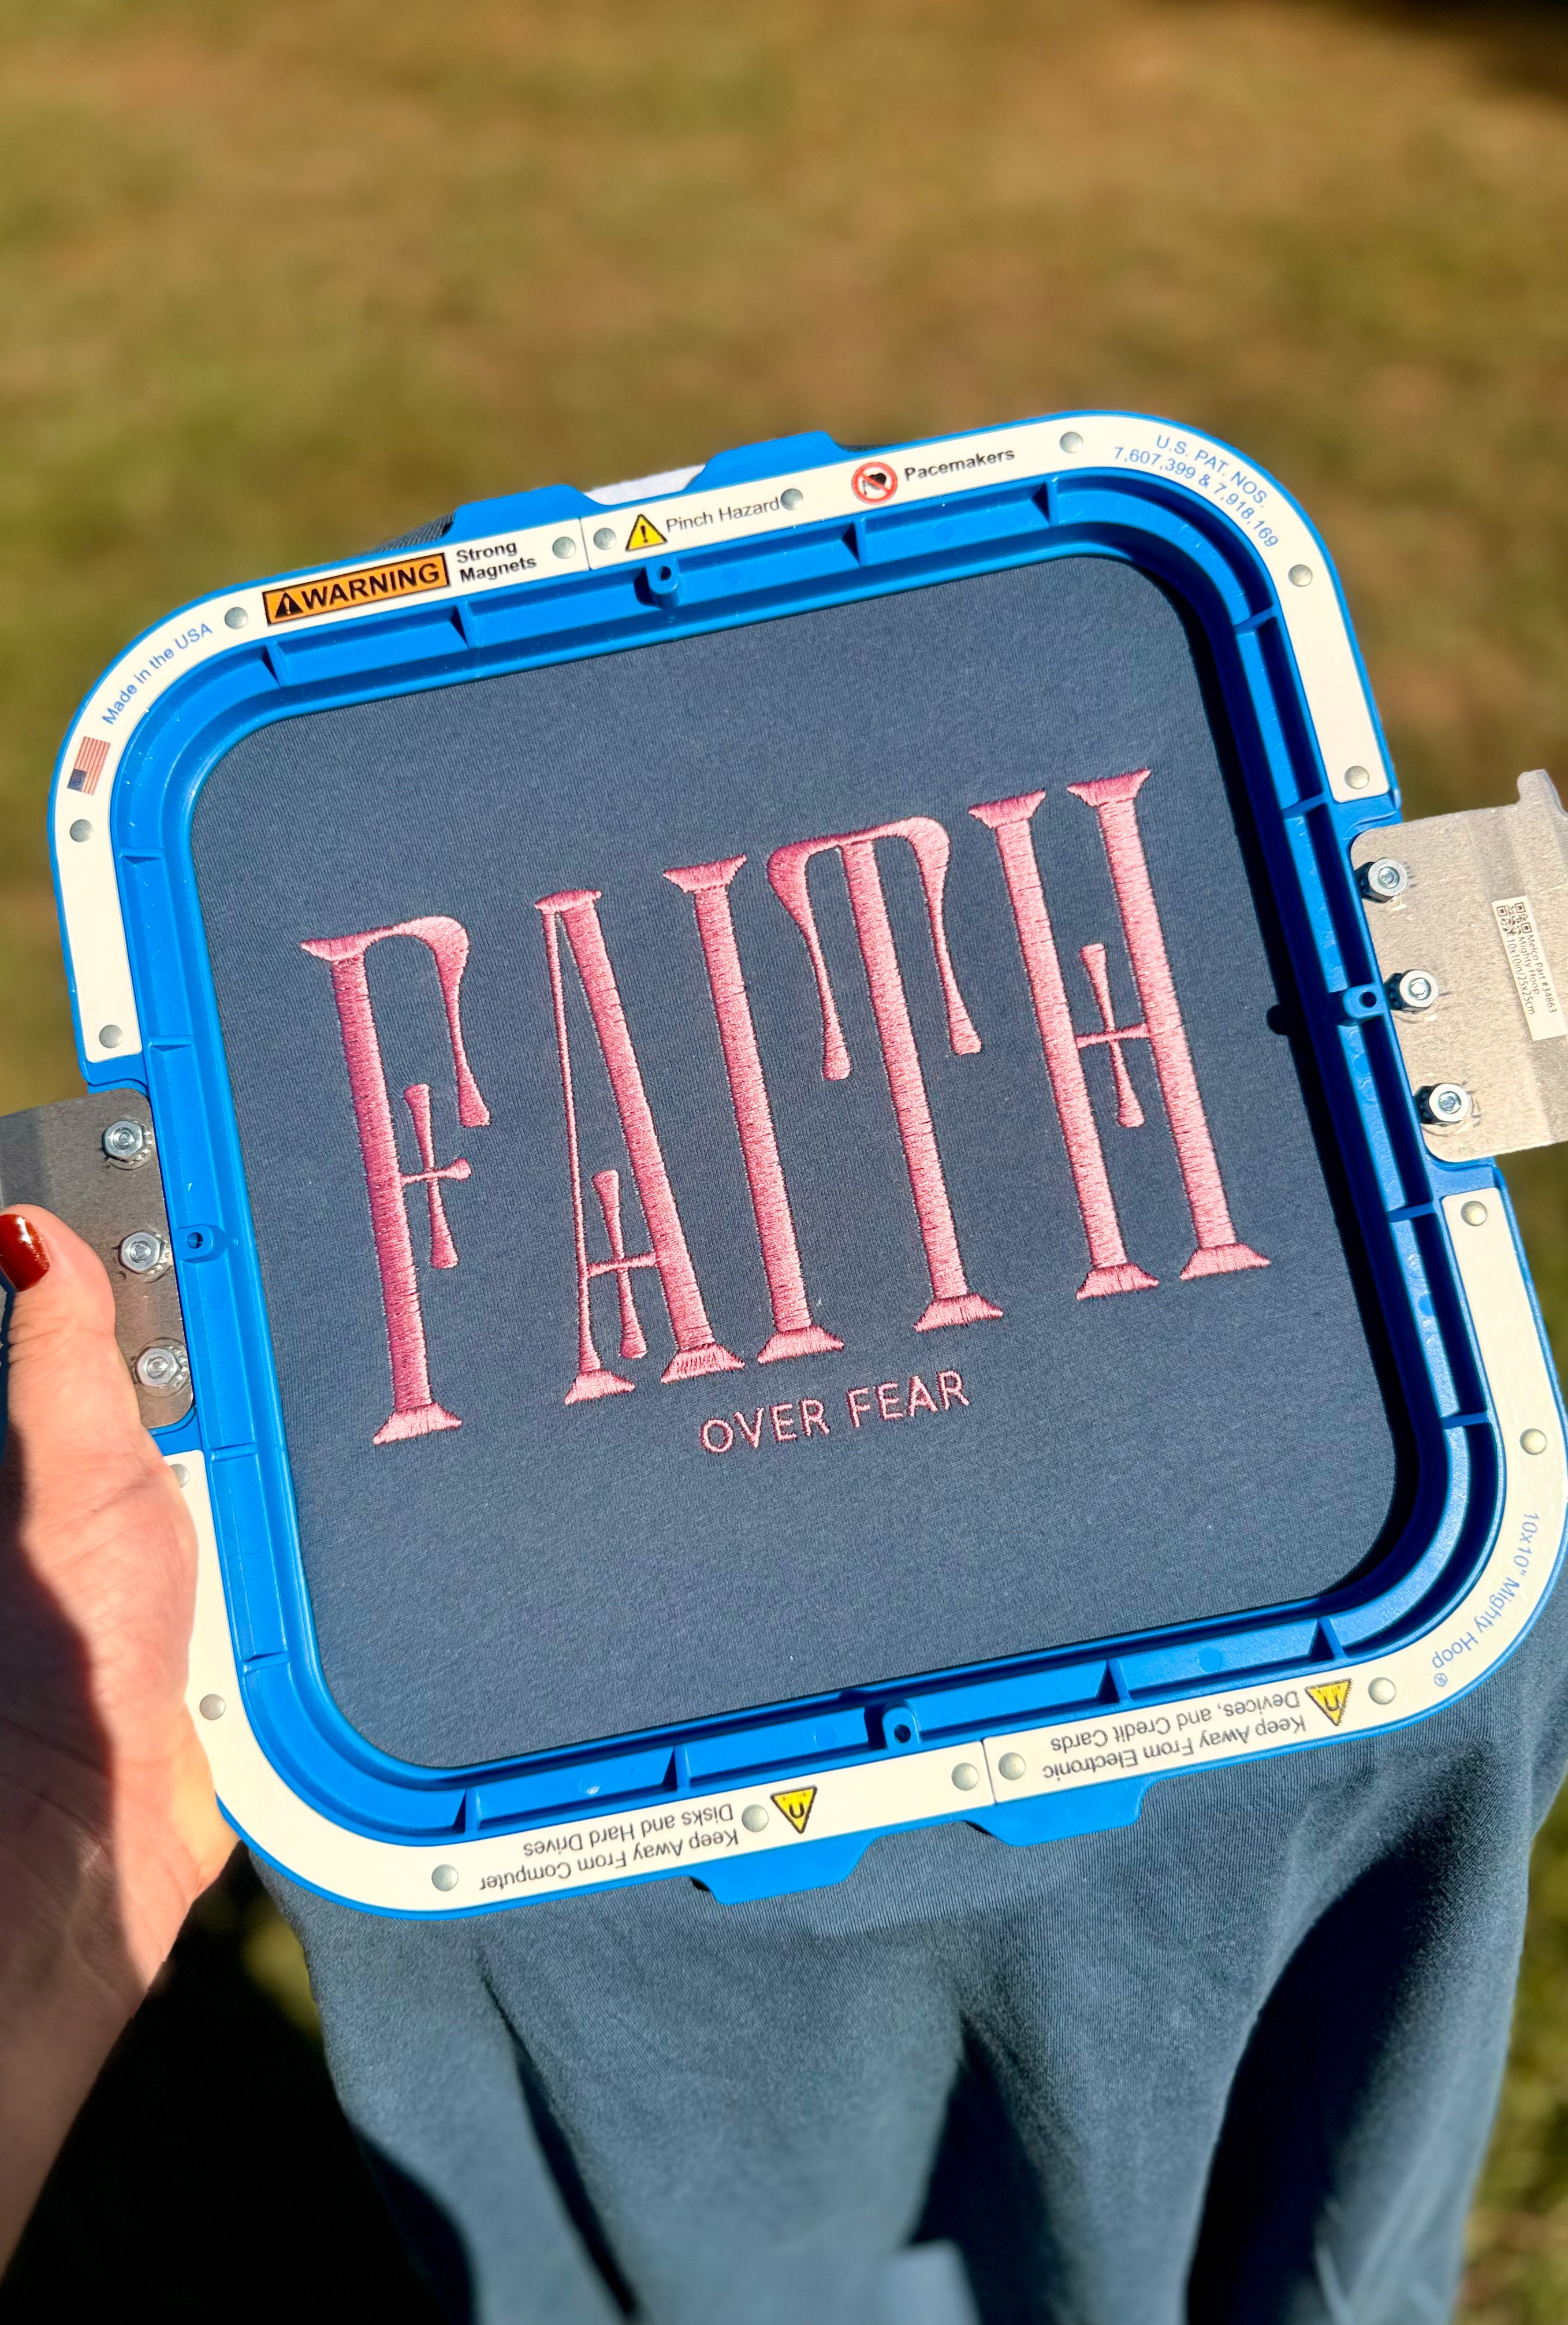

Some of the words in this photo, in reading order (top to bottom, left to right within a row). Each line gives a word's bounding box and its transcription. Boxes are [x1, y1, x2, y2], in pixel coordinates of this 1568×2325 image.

[904, 447, 1015, 481] Pacemakers
[1156, 434, 1188, 457] U.S.
[1194, 449, 1229, 477] PAT.
[1231, 471, 1268, 508] NOS.
[1113, 447, 1196, 479] 7,607,399
[1198, 474, 1211, 488] &
[1213, 483, 1279, 547] 7,918,169
[665, 511, 713, 533] Pinch
[717, 497, 781, 521] Hazard
[456, 542, 517, 563] Strong
[459, 557, 537, 583] Magnets
[301, 562, 440, 607] WARNING
[102, 684, 137, 725] Made
[149, 648, 174, 669] the
[174, 623, 213, 649] USA
[1527, 935, 1539, 961] Melco
[1506, 938, 1535, 1015] 10x10in/25x25cm
[1518, 936, 1532, 968] Mighty
[1528, 969, 1540, 995] Hoop
[1535, 961, 1546, 980] Part
[1540, 981, 1558, 1013] #34863
[300, 769, 1271, 1444] FAITH
[700, 1398, 830, 1453] OVER
[846, 1369, 970, 1427] FEAR
[1473, 1576, 1520, 1633] Mighty
[1432, 1631, 1478, 1669] Hoop
[1216, 1690, 1300, 1717] Devices,
[1114, 1717, 1171, 1743] Credit
[1176, 1708, 1212, 1731] and
[1255, 1715, 1307, 1737] Keep
[1050, 1729, 1109, 1753] Cards
[1144, 1738, 1194, 1760] From
[1199, 1724, 1250, 1750] Away
[1042, 1749, 1138, 1783] Electronic
[642, 1814, 676, 1837] and
[682, 1803, 732, 1825] Disks
[523, 1835, 583, 1857] Drives
[590, 1821, 635, 1846] Hard
[689, 1828, 739, 1850] Keep
[578, 1850, 627, 1873] From
[632, 1838, 683, 1862] Away
[479, 1860, 572, 1891] Computer
